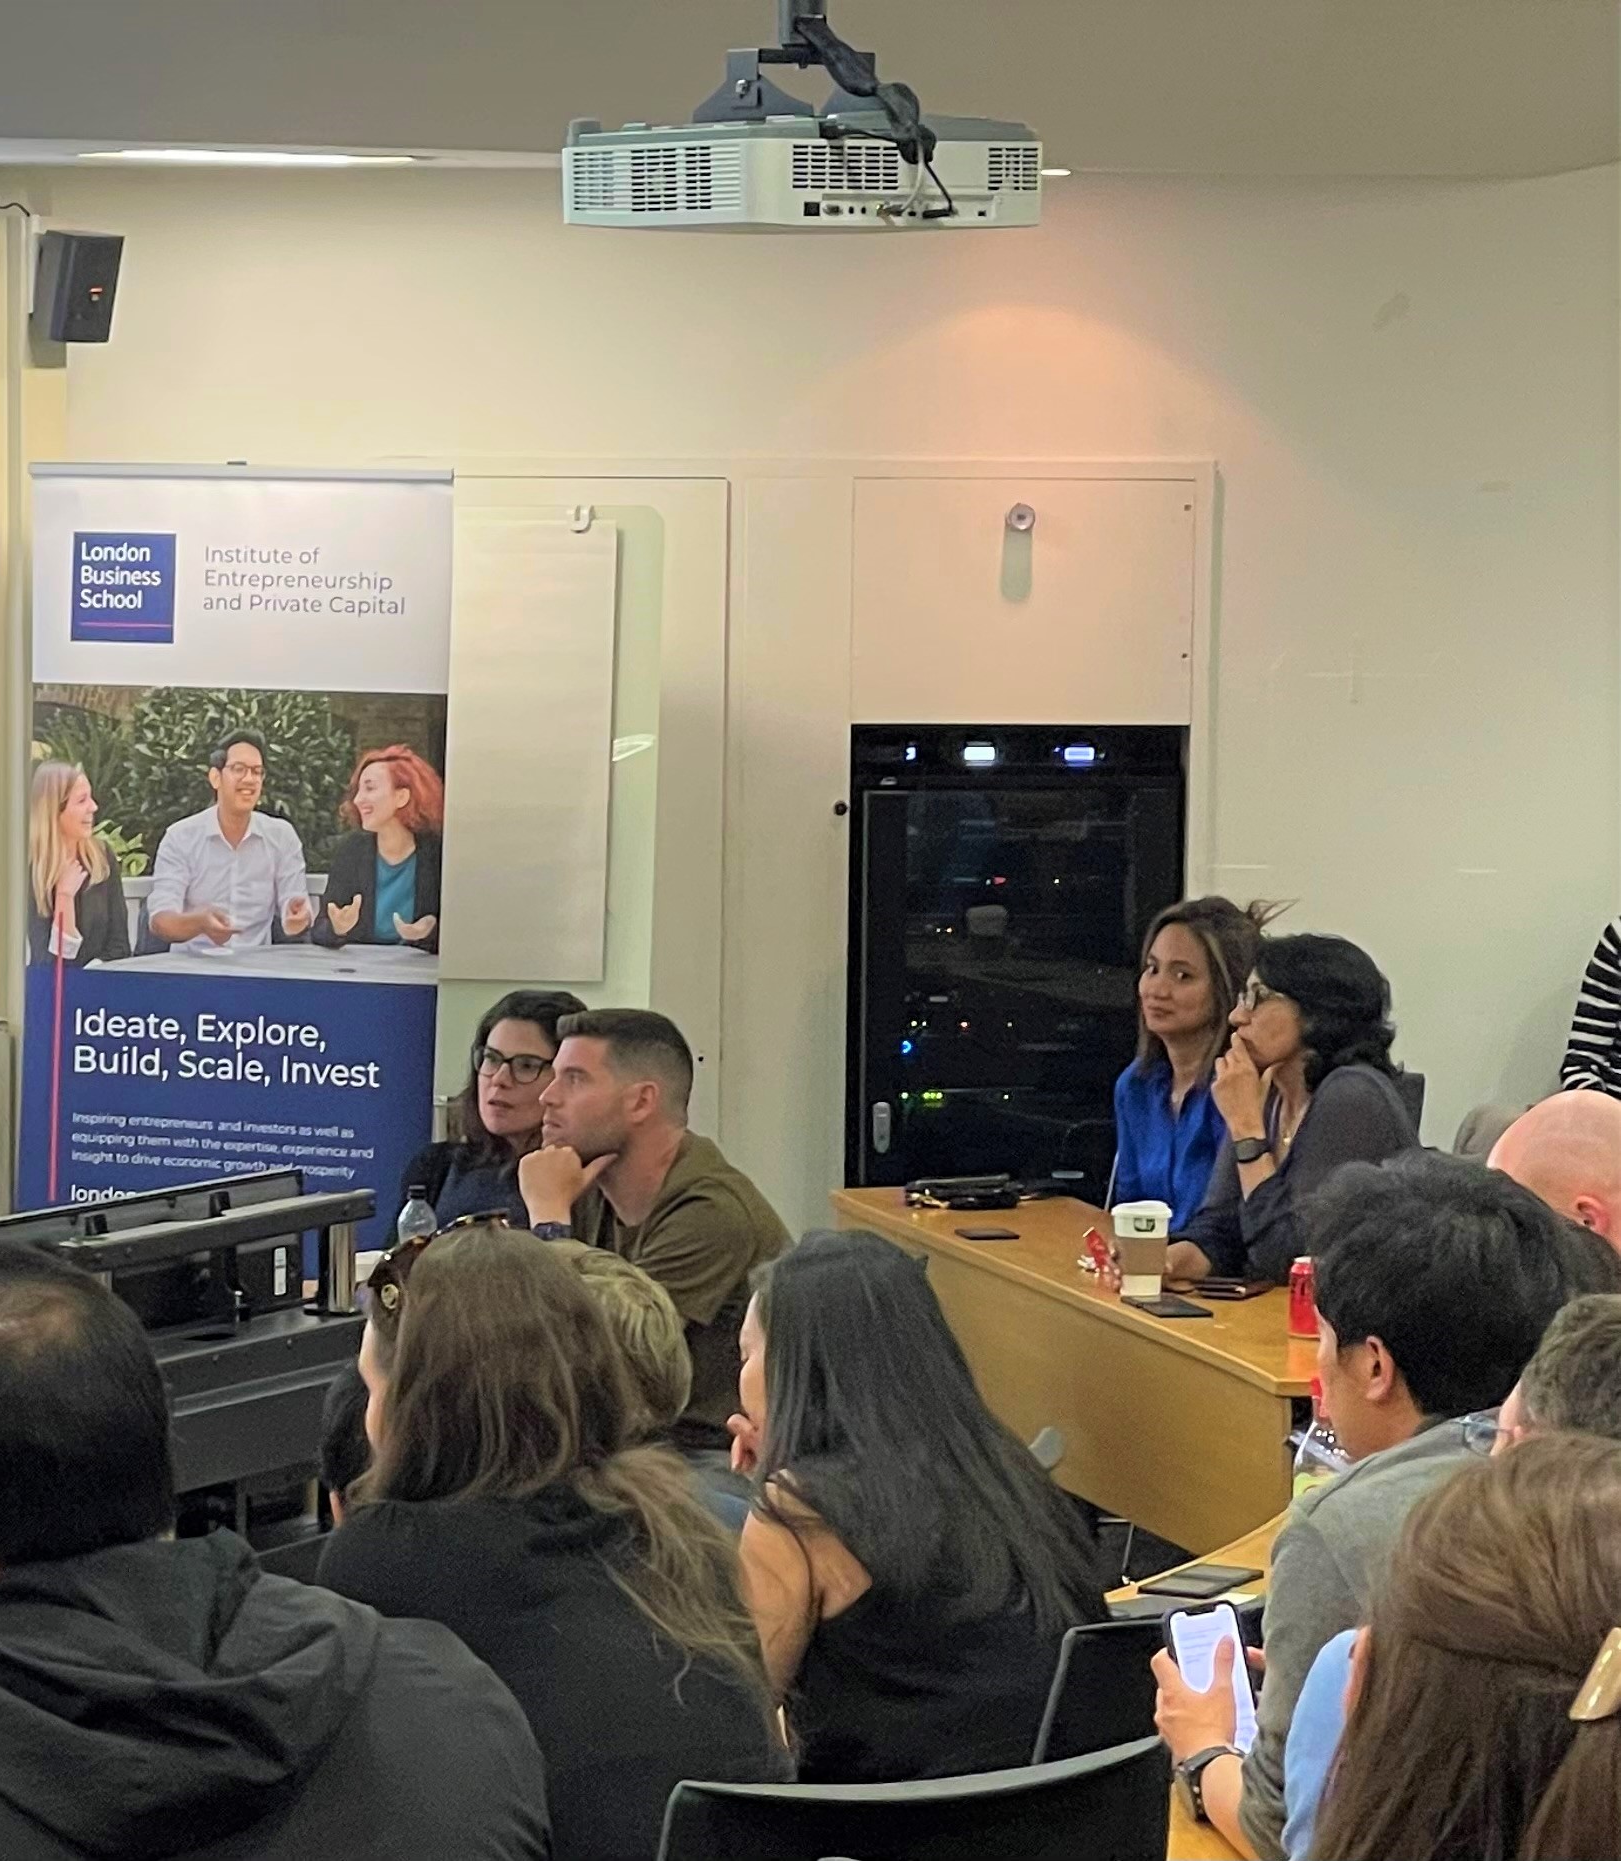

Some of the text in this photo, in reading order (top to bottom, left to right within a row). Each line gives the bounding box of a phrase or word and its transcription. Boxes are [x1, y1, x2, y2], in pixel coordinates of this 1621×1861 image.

[81, 542, 151, 562] London
[204, 546, 320, 565] Institute of
[81, 565, 161, 587] Business
[204, 570, 393, 593] Entrepreneurship
[80, 589, 143, 609] School
[203, 593, 405, 618] and Private Capital
[75, 1007, 326, 1053] Ideate, Explore,
[74, 1045, 380, 1088] Build, Scale, Invest
[72, 1112, 127, 1128] Inspiring
[129, 1116, 214, 1130] entrepreneurs
[218, 1121, 242, 1131] and
[243, 1121, 297, 1136] investors
[314, 1126, 339, 1137] well
[72, 1132, 136, 1147] equipping
[137, 1135, 171, 1146] them
[173, 1136, 199, 1148] with
[201, 1137, 222, 1150] the
[282, 1144, 348, 1158] experience
[349, 1146, 374, 1159] and
[116, 1153, 129, 1164] to
[131, 1152, 161, 1166] drive
[163, 1157, 222, 1169] economic
[223, 1160, 267, 1173] growth
